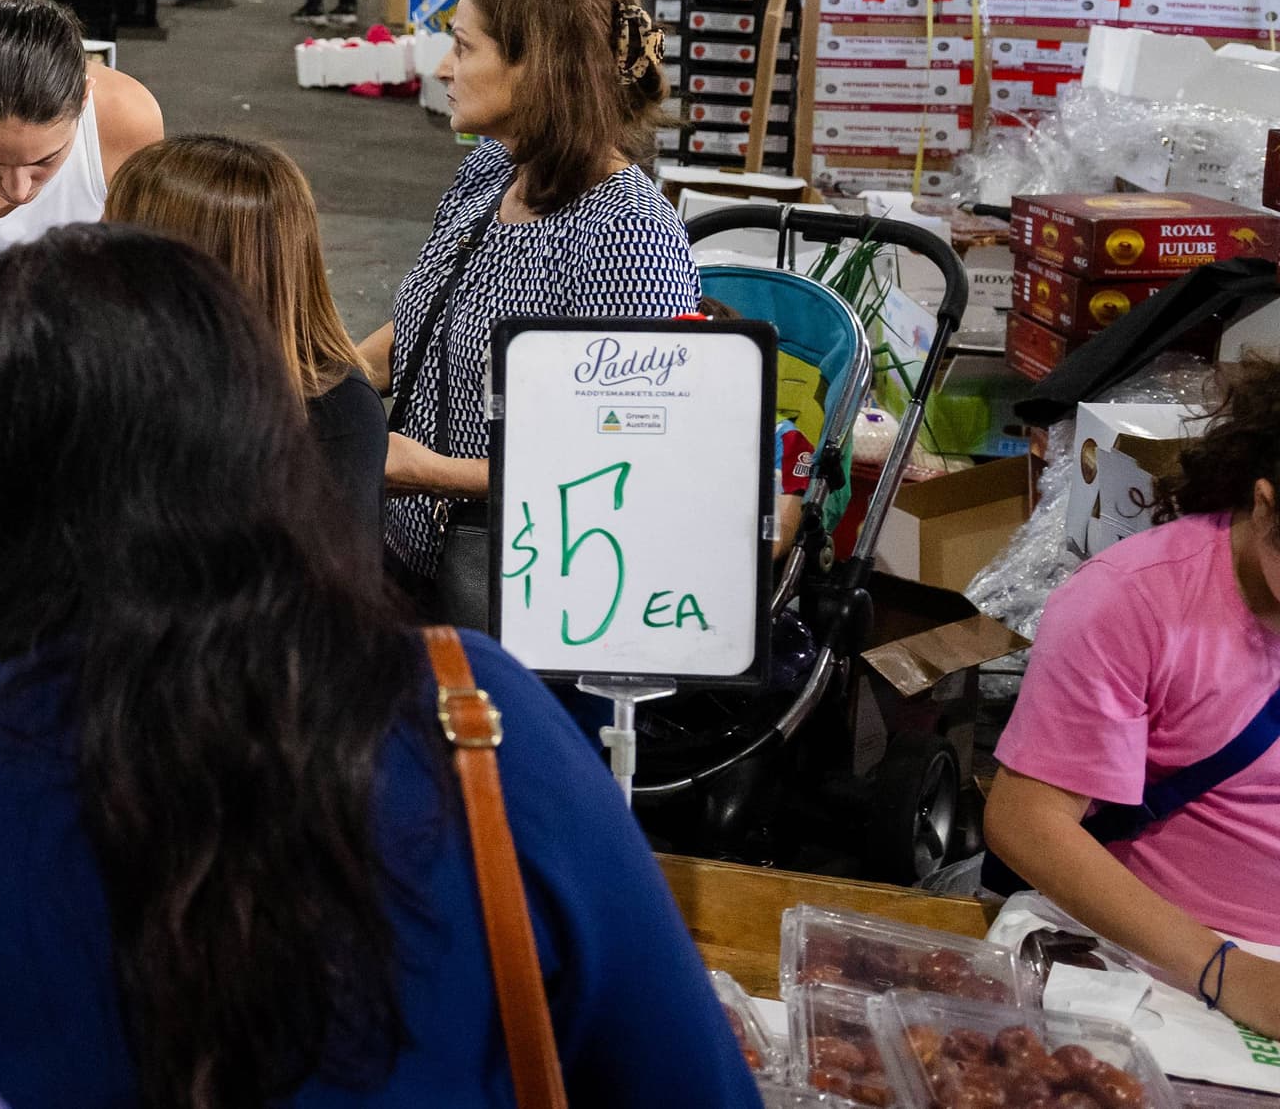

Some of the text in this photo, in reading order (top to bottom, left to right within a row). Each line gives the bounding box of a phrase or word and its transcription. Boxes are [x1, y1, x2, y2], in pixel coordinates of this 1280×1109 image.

[1159, 224, 1214, 238] ROYAL
[1158, 242, 1216, 256] JUJUBE
[575, 337, 688, 386] Paddy's
[575, 390, 690, 398] PADDYSMARKETS.COM.AU
[625, 412, 660, 420] Grown in
[625, 421, 662, 429] Australia
[502, 462, 710, 647] $5 EA
